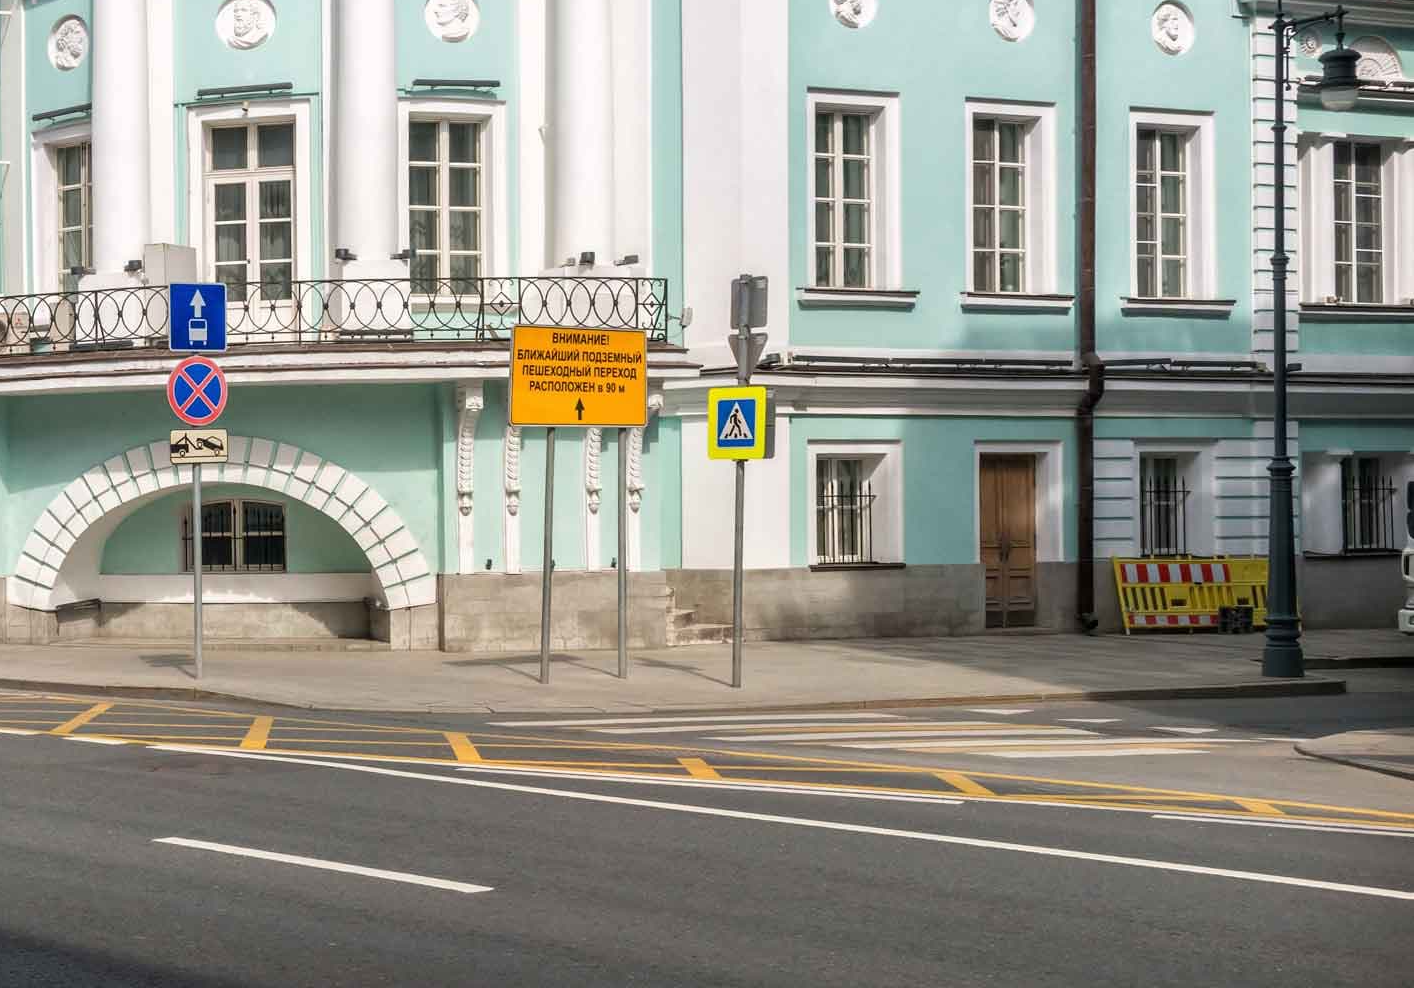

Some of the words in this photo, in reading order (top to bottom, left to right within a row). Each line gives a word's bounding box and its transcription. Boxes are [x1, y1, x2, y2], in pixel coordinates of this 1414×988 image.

[552, 332, 610, 345] ВНИМАНИЕ!
[517, 349, 580, 362] БЛИЖАЙШИЙ
[582, 351, 642, 364] ПОДЗЕМНЫЙ
[522, 364, 591, 378] ПЕШЕХОДНЫЙ
[593, 366, 637, 380] ПЕРЕХОД
[529, 381, 595, 393] РАСПОЛОЖЕН
[606, 383, 616, 393] 90
